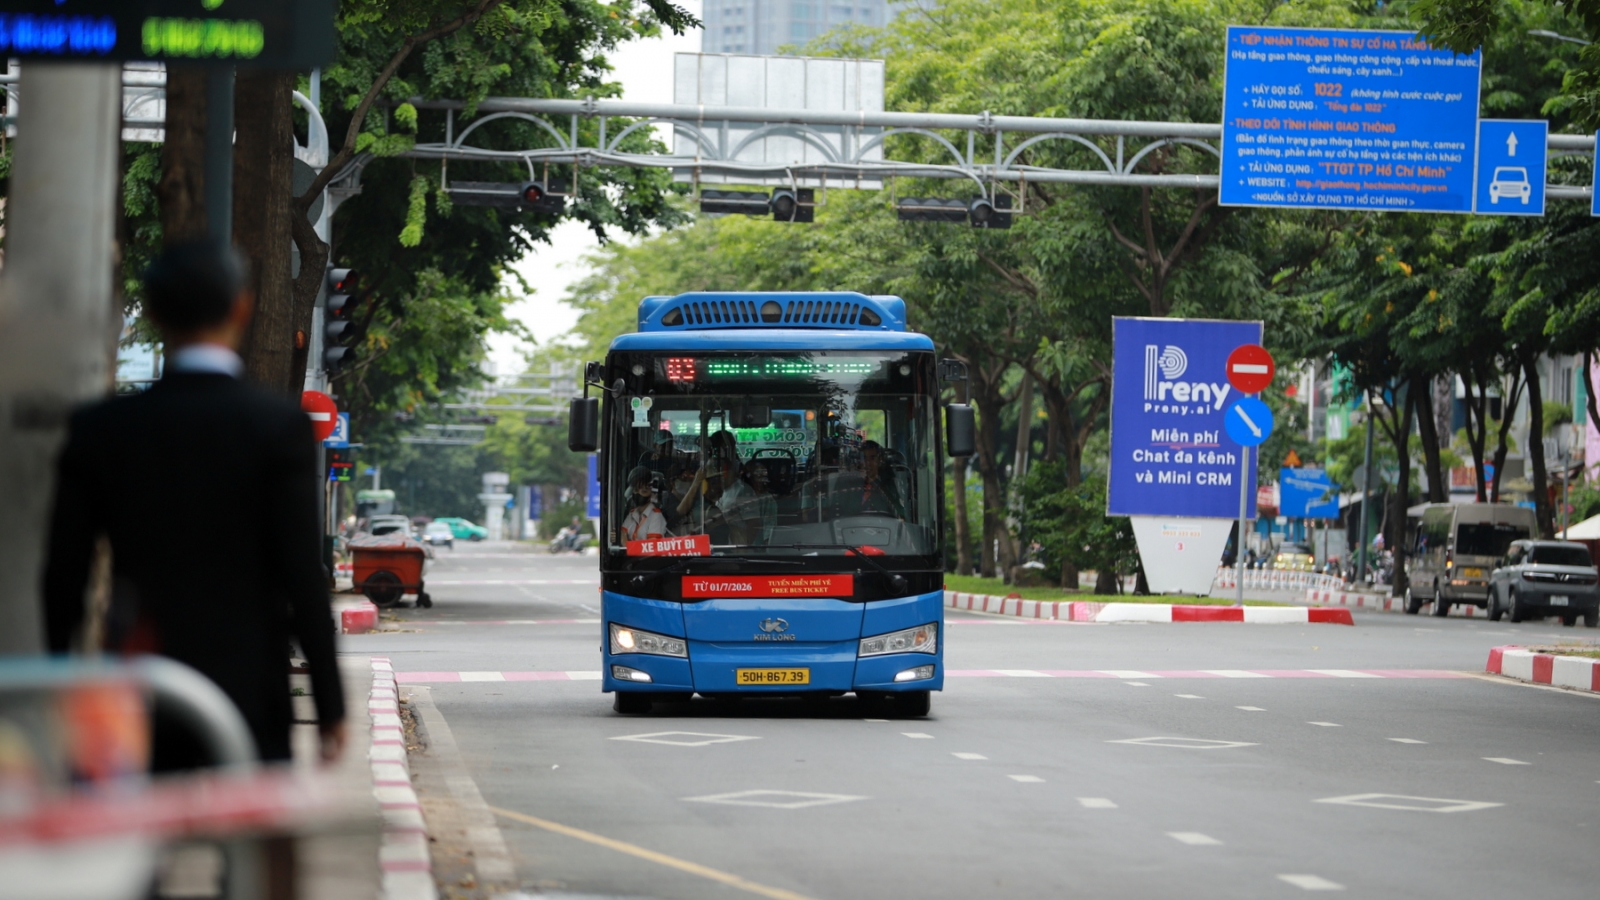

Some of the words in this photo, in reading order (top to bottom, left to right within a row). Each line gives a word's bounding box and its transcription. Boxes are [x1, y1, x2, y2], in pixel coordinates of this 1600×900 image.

[1240, 32, 1261, 45] TIẾP
[1264, 35, 1293, 48] NHẬN
[1296, 34, 1330, 47] THÔNG
[1332, 38, 1348, 48] TIN
[1350, 38, 1364, 49] SỰ
[1367, 36, 1381, 49] CỐ
[1383, 40, 1396, 51] HẠ
[1400, 36, 1427, 50] TẦNG
[1232, 50, 1246, 60] (Hạ
[1248, 50, 1266, 62] tầng
[1268, 52, 1286, 62] giao
[1287, 52, 1313, 64] thông,
[1315, 54, 1333, 64] giao
[1334, 54, 1358, 65] thông
[1360, 54, 1379, 65] công
[1382, 55, 1404, 66] cộng,
[1406, 55, 1420, 66] cấp
[1422, 57, 1432, 66] và
[1433, 57, 1454, 66] thoát
[1456, 58, 1479, 68] nước,
[1308, 64, 1330, 74] chiếu
[1332, 65, 1355, 77] sáng,
[1356, 66, 1370, 77] cây
[1252, 83, 1269, 95] HÃY
[1271, 85, 1286, 97] GỌI
[1314, 82, 1342, 96] 1022
[1350, 88, 1381, 100] (không
[1382, 89, 1399, 99] tính
[1401, 90, 1422, 100] cước
[1424, 91, 1444, 102] cuộc
[1445, 92, 1462, 102] gọi)
[1251, 96, 1265, 108] TẢI
[1268, 98, 1286, 109] ỨNG
[1350, 103, 1362, 112] đài
[1365, 103, 1387, 112] 1022"
[1235, 118, 1261, 129] THEO
[1264, 118, 1280, 129] DÕI
[1283, 119, 1306, 130] TÌNH
[1308, 119, 1333, 131] HÌNH
[1336, 122, 1360, 132] GIAO
[1362, 120, 1396, 133] THÔNG
[1236, 133, 1255, 143] (Bản
[1257, 134, 1267, 143] đồ
[1268, 134, 1284, 144] tình
[1286, 136, 1308, 146] trạng
[1310, 137, 1328, 147] giao
[1329, 136, 1353, 148] thông
[1354, 138, 1373, 148] theo
[1374, 137, 1390, 148] thời
[1392, 140, 1410, 149] gian
[1411, 140, 1432, 150] thực,
[1434, 142, 1465, 150] camera
[1238, 148, 1255, 157] giao
[1257, 147, 1284, 158] thông,
[1285, 147, 1305, 158] phản
[1307, 148, 1322, 158] ánh
[1324, 150, 1335, 159] sự
[1337, 148, 1348, 158] cố
[1349, 150, 1359, 160] hạ
[1361, 149, 1378, 160] tầng
[1381, 150, 1390, 160] và
[1392, 151, 1406, 160] các
[1408, 152, 1423, 162] tiện
[1425, 152, 1437, 161] ích
[1439, 153, 1461, 163] khác)
[1248, 160, 1262, 172] TẢI
[1264, 162, 1283, 173] ỨNG
[1318, 162, 1355, 175] "TTGT
[1358, 164, 1373, 175] TP
[1376, 163, 1392, 176] Hồ
[1396, 165, 1415, 177] Chí
[1418, 166, 1452, 178] Minh"
[1287, 191, 1298, 202] SỞ
[1300, 192, 1315, 203] XÂY
[1317, 195, 1342, 205] DỰNG
[1357, 193, 1368, 204] HỒ
[1370, 195, 1384, 205] CHÍ
[1386, 196, 1407, 205] MINH
[1144, 344, 1230, 410] Preny
[1144, 402, 1210, 416] Preny.ai
[1151, 428, 1189, 442] Miễn
[1194, 430, 1219, 446] phí
[1132, 449, 1170, 462] Chat
[1174, 450, 1192, 463] đa
[1198, 450, 1236, 465] kênh
[1135, 470, 1153, 483] và
[1158, 471, 1190, 484] Mini
[1196, 472, 1232, 486] CRM
[641, 542, 654, 553] XE
[657, 539, 682, 551] BUÝT
[685, 539, 695, 549] ĐI
[1178, 542, 1183, 550] 3
[693, 581, 708, 591] TỪ
[710, 583, 752, 591] 01/7/2026
[791, 578, 808, 586] MIỄN
[743, 672, 804, 682] 50H-867.39
